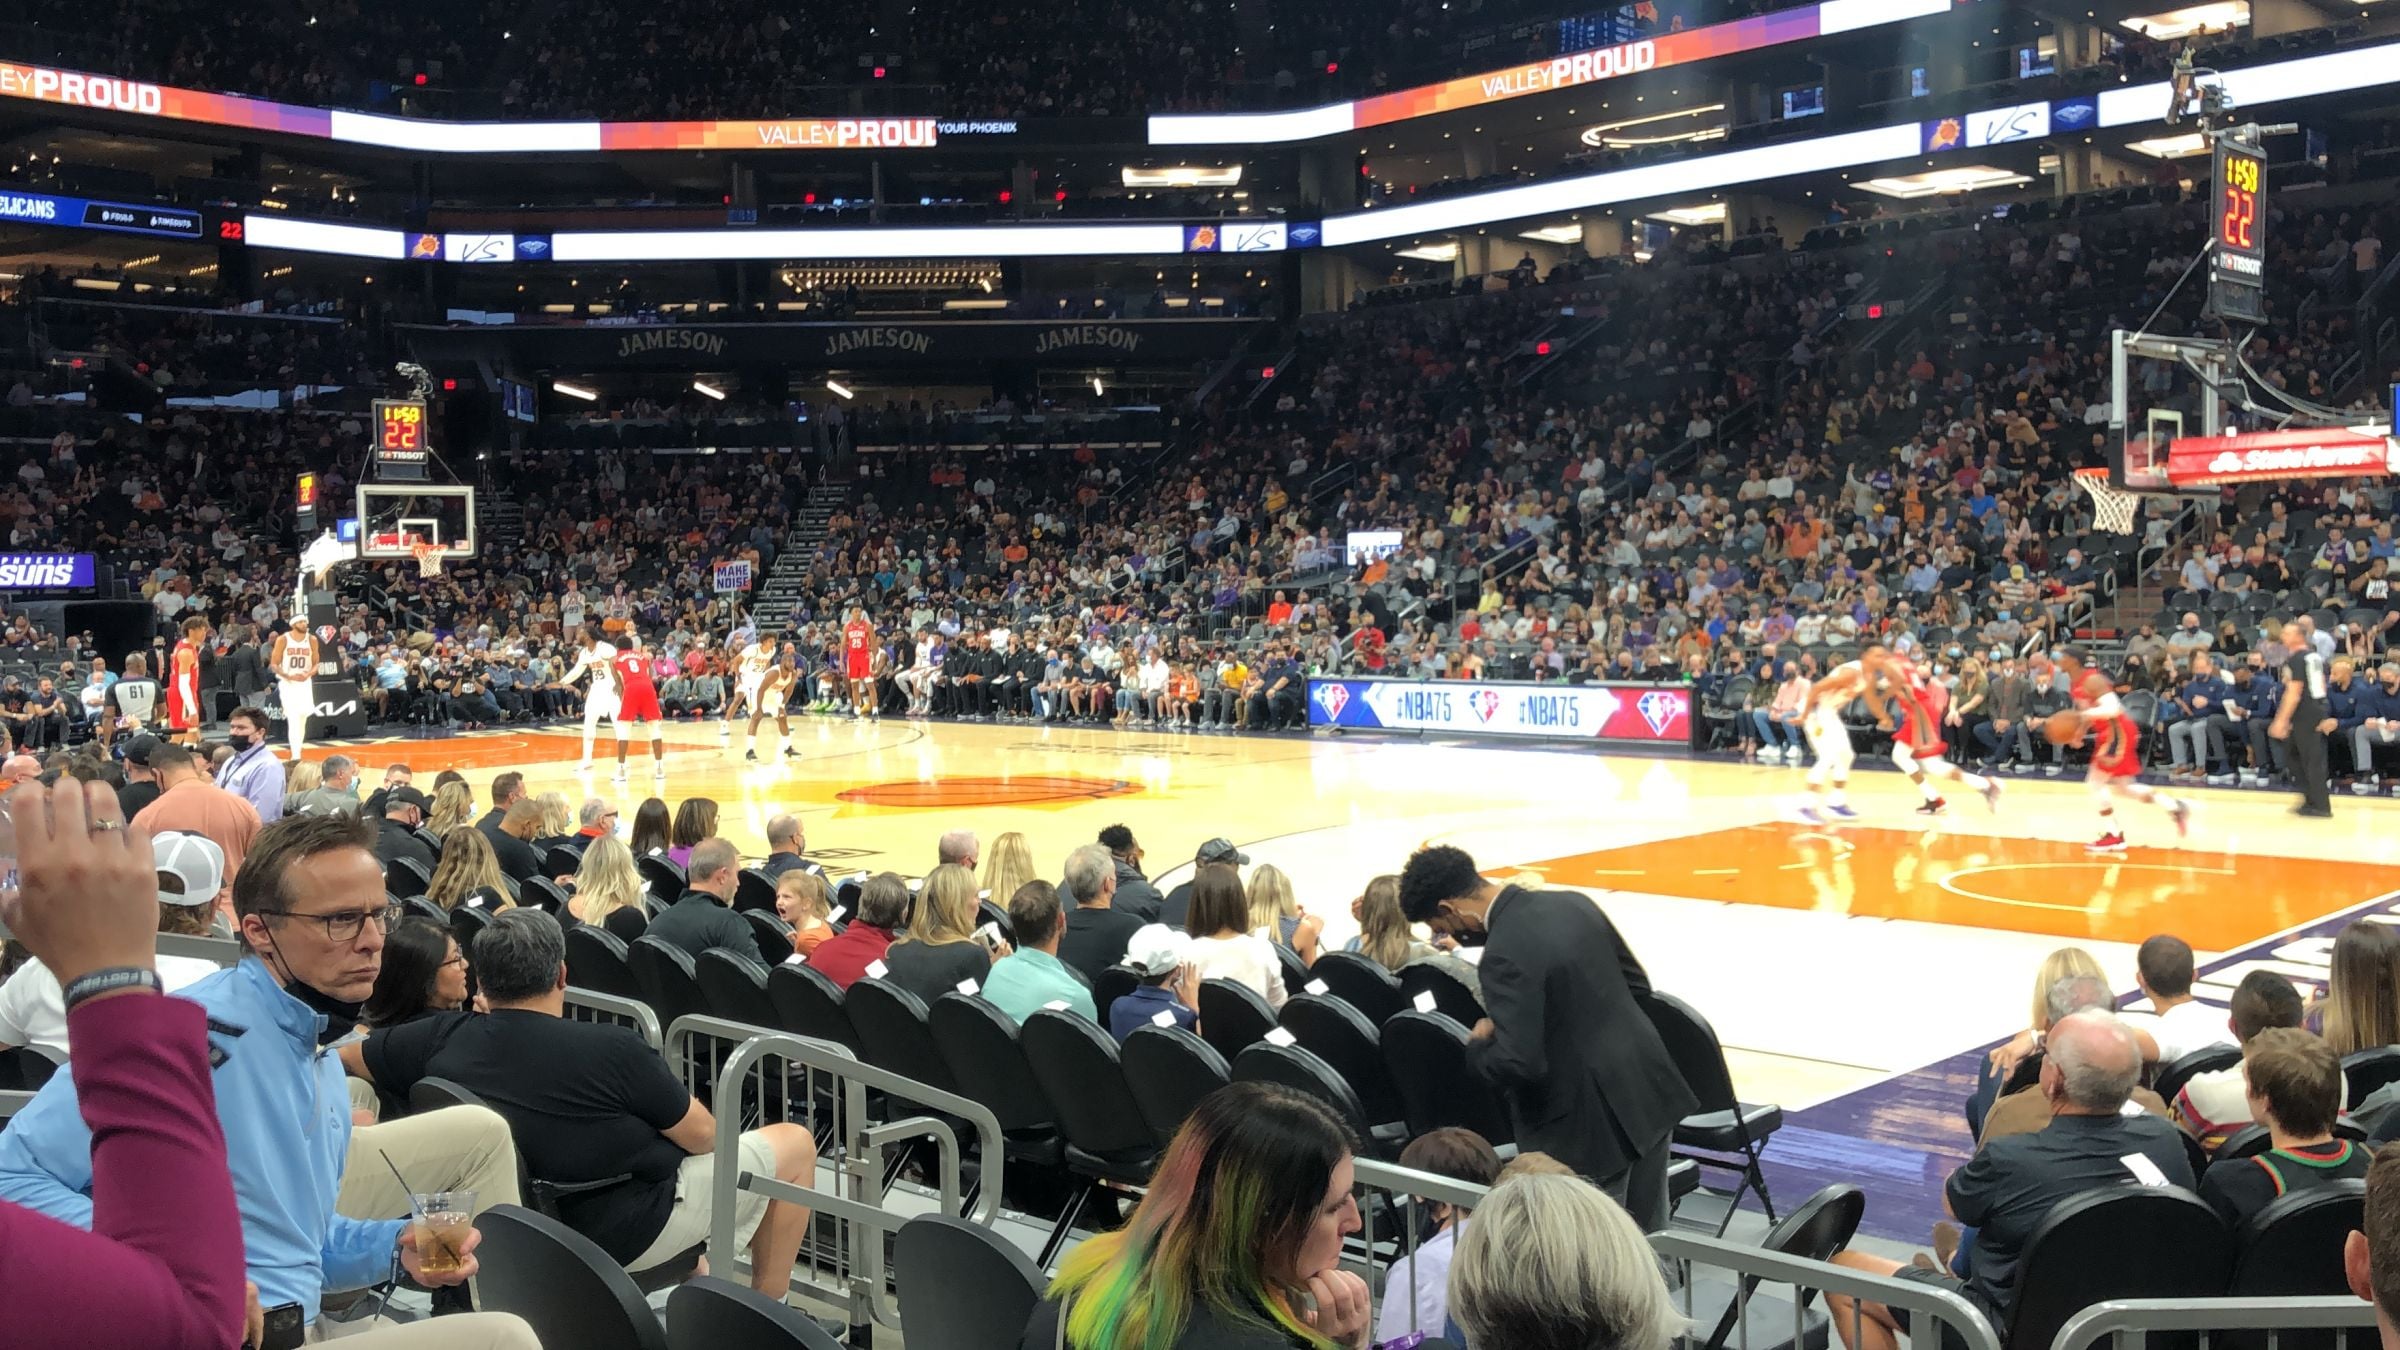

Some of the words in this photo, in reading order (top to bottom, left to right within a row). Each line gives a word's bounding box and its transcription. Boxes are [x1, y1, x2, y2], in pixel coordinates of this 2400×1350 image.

[938, 122, 968, 134] YOUR
[969, 122, 1017, 134] PHOENIX
[2227, 157, 2258, 193] 11:58
[2224, 189, 2253, 248] 22
[220, 221, 243, 240] 22
[1237, 224, 1278, 251] VS
[462, 234, 505, 261] VS
[2233, 257, 2262, 276] TISSOT
[618, 328, 725, 357] JAMESON
[825, 327, 929, 356] JAMESON
[1035, 325, 1139, 353] JAMESON
[384, 421, 416, 449] 22
[391, 451, 425, 460] TISSOT
[2243, 449, 2304, 471] State
[1, 556, 75, 565] PHOENIX
[717, 564, 748, 577] MAKE
[716, 577, 749, 589] NOISE
[852, 638, 862, 648] 25
[289, 656, 306, 669] 00
[628, 659, 640, 673] 8
[129, 685, 144, 699] 61
[1397, 691, 1452, 722] #NBA75
[1519, 695, 1579, 727] #NBA75
